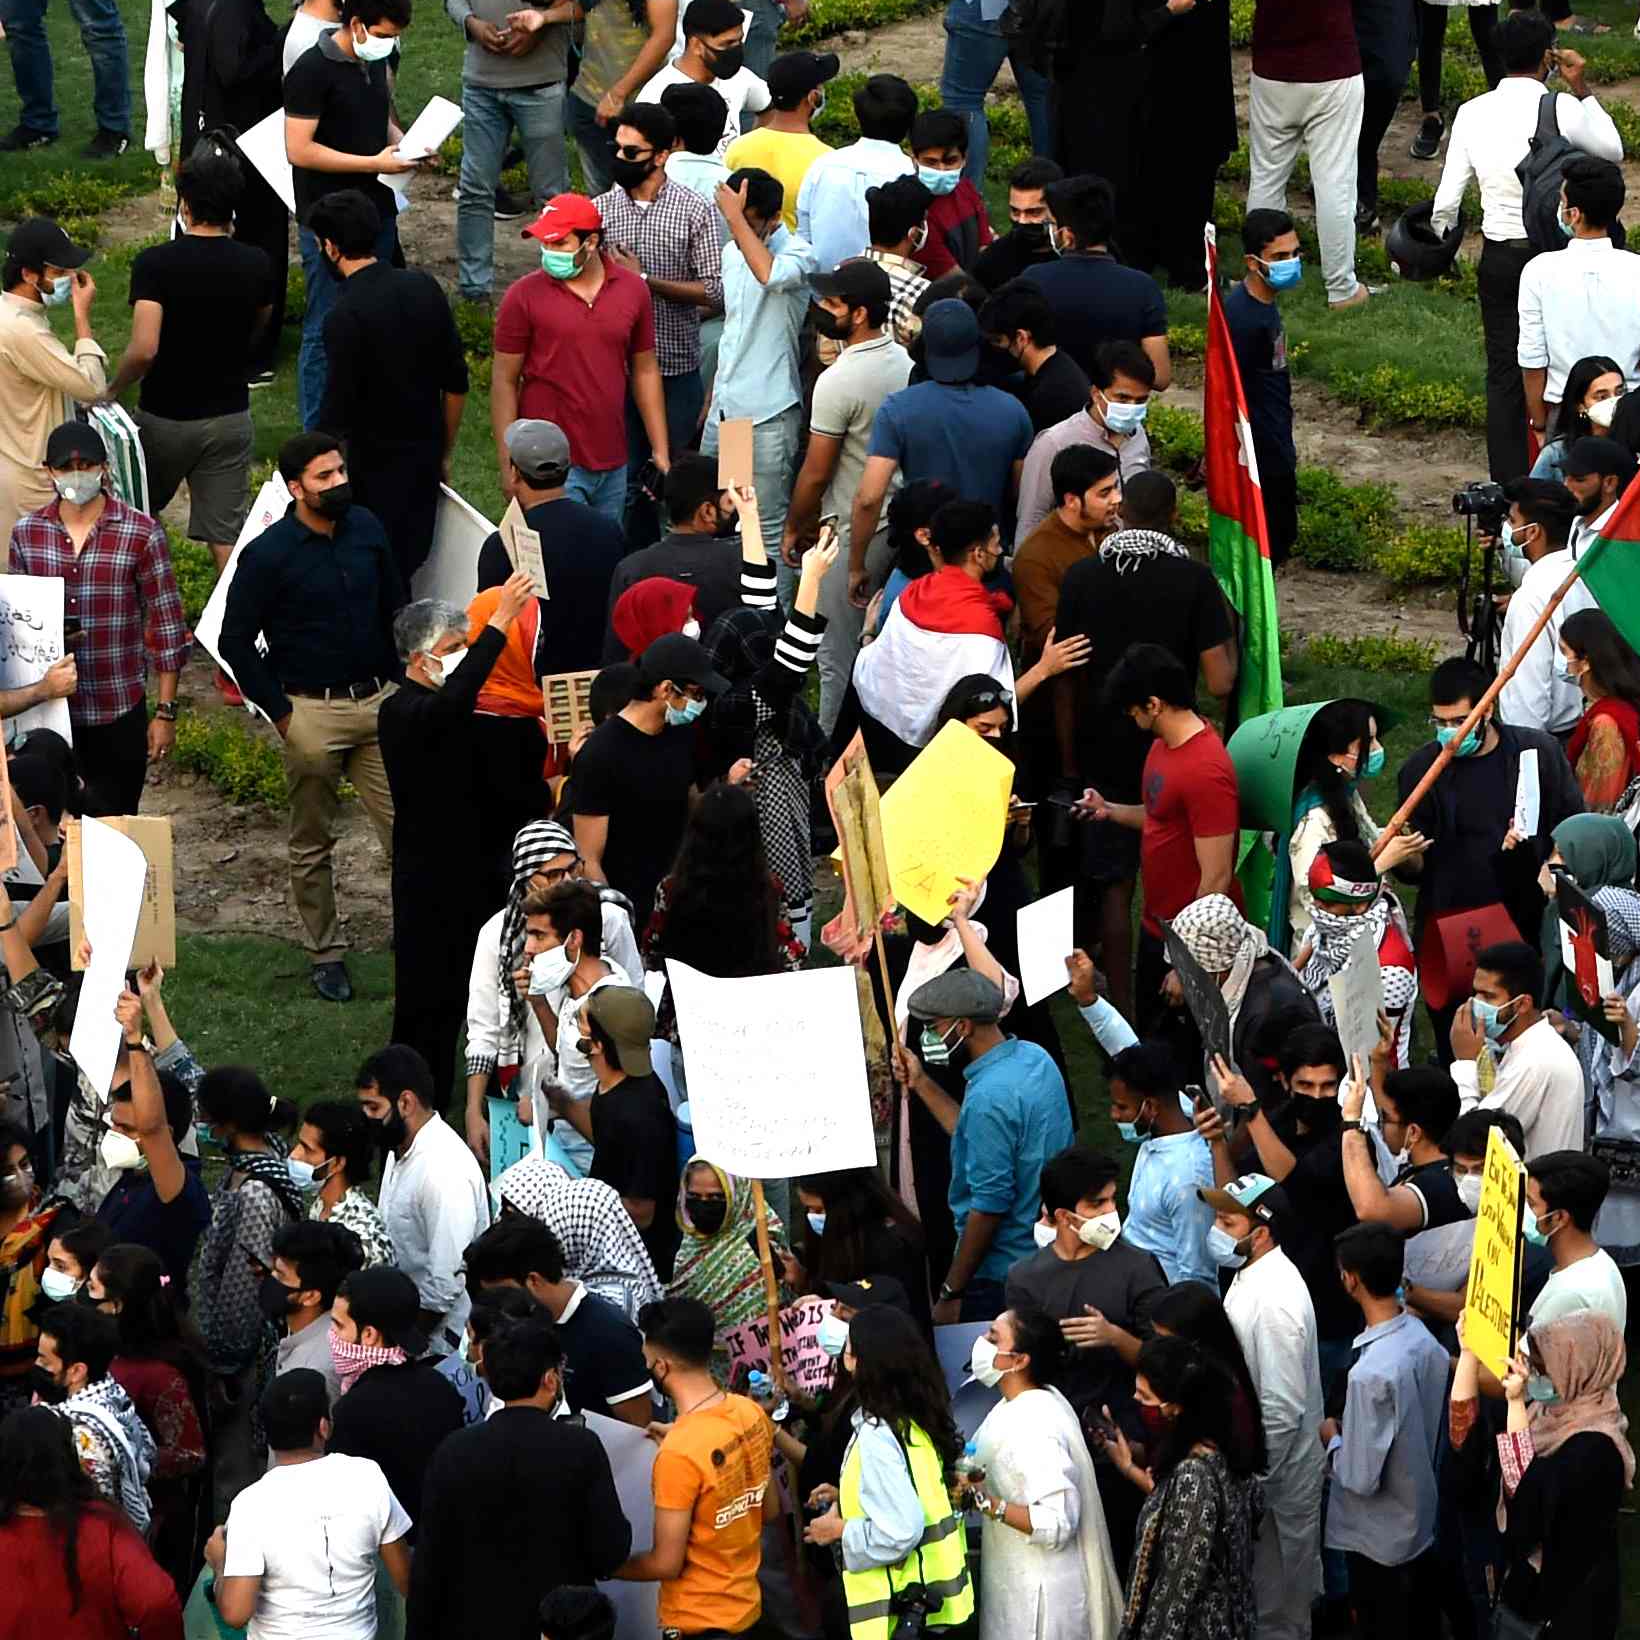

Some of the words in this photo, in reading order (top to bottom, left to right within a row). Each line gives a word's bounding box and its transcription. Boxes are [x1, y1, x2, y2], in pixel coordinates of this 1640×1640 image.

[726, 1332, 747, 1358] IF
[749, 1322, 769, 1348] TH
[807, 1304, 824, 1326] IS
